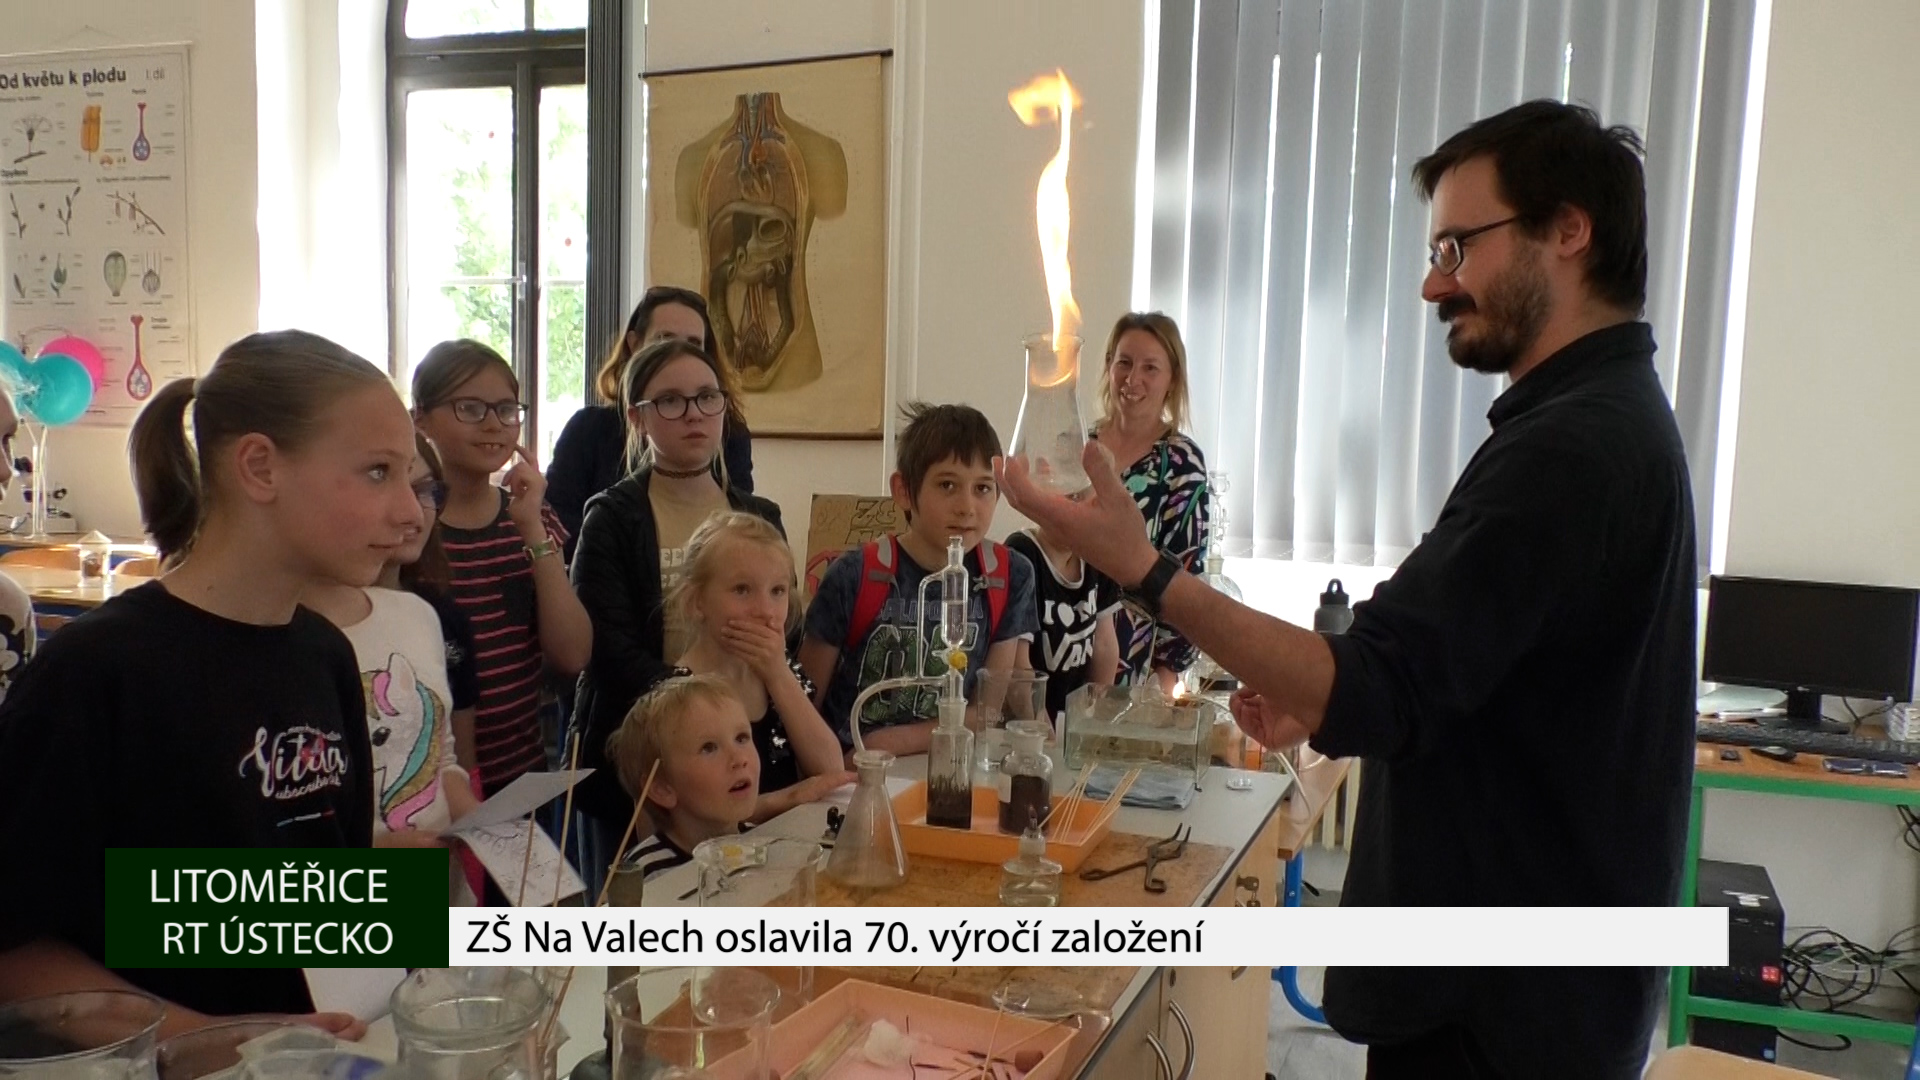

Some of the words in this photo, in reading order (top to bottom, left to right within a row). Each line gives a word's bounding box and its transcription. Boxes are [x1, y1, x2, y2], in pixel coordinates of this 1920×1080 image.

[22, 70, 64, 88] květu
[69, 70, 78, 85] k
[82, 67, 126, 87] plodu
[1042, 620, 1097, 672] VAN
